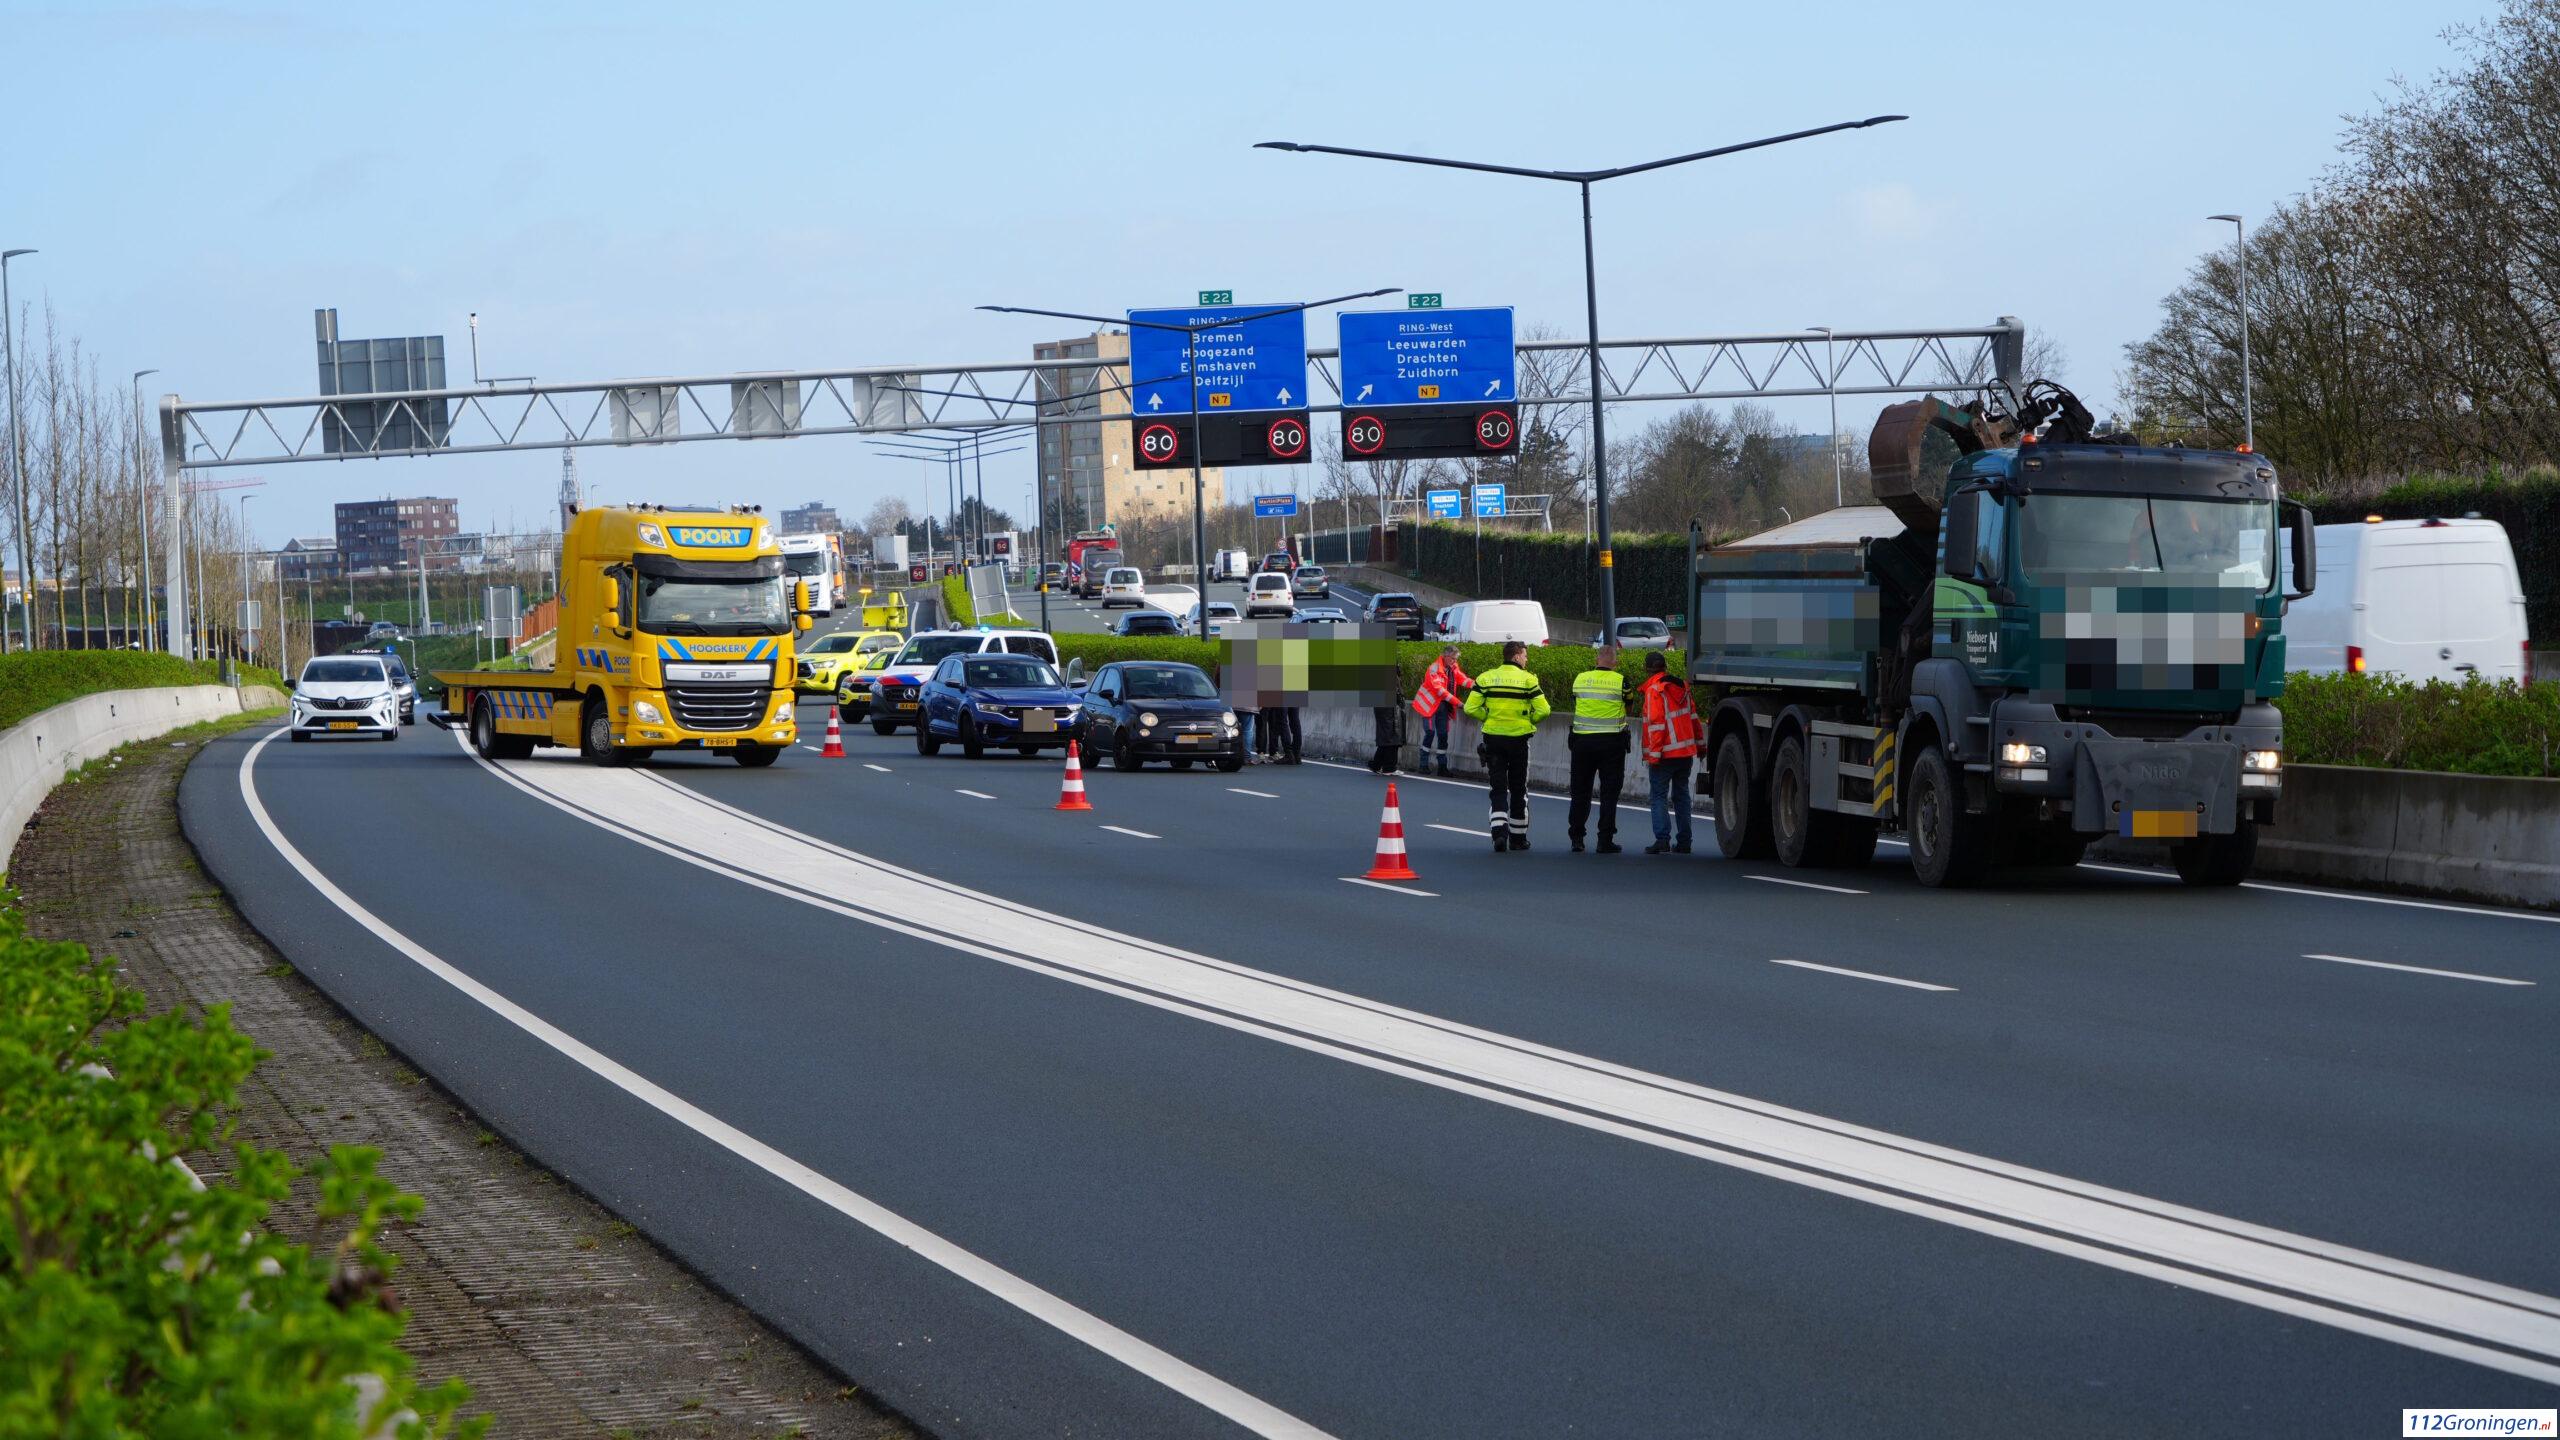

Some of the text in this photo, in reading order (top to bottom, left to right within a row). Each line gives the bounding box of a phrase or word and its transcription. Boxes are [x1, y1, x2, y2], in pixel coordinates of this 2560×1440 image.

[1202, 293, 1230, 303] E 22
[1411, 296, 1439, 306] E 22
[1399, 323, 1453, 332] RING-West
[1192, 333, 1243, 343] Bremen
[1387, 338, 1467, 350] Leeuwarden
[1182, 346, 1254, 360] Hoogezand
[1397, 353, 1458, 364] Drachten
[1181, 361, 1256, 373] Emshaven
[1397, 368, 1459, 379] Zuidhorn
[1195, 374, 1244, 388] Delfzijl
[1420, 388, 1437, 396] N 7
[1212, 395, 1228, 404] N 7
[1351, 427, 1381, 443] 80
[1481, 421, 1510, 438] 80
[1144, 435, 1173, 451] 80
[1272, 429, 1301, 446] 80
[680, 528, 743, 545] POORT
[1967, 630, 1987, 643] Nieboer
[689, 644, 748, 654] HOOGKERK
[700, 671, 737, 679] DAF
